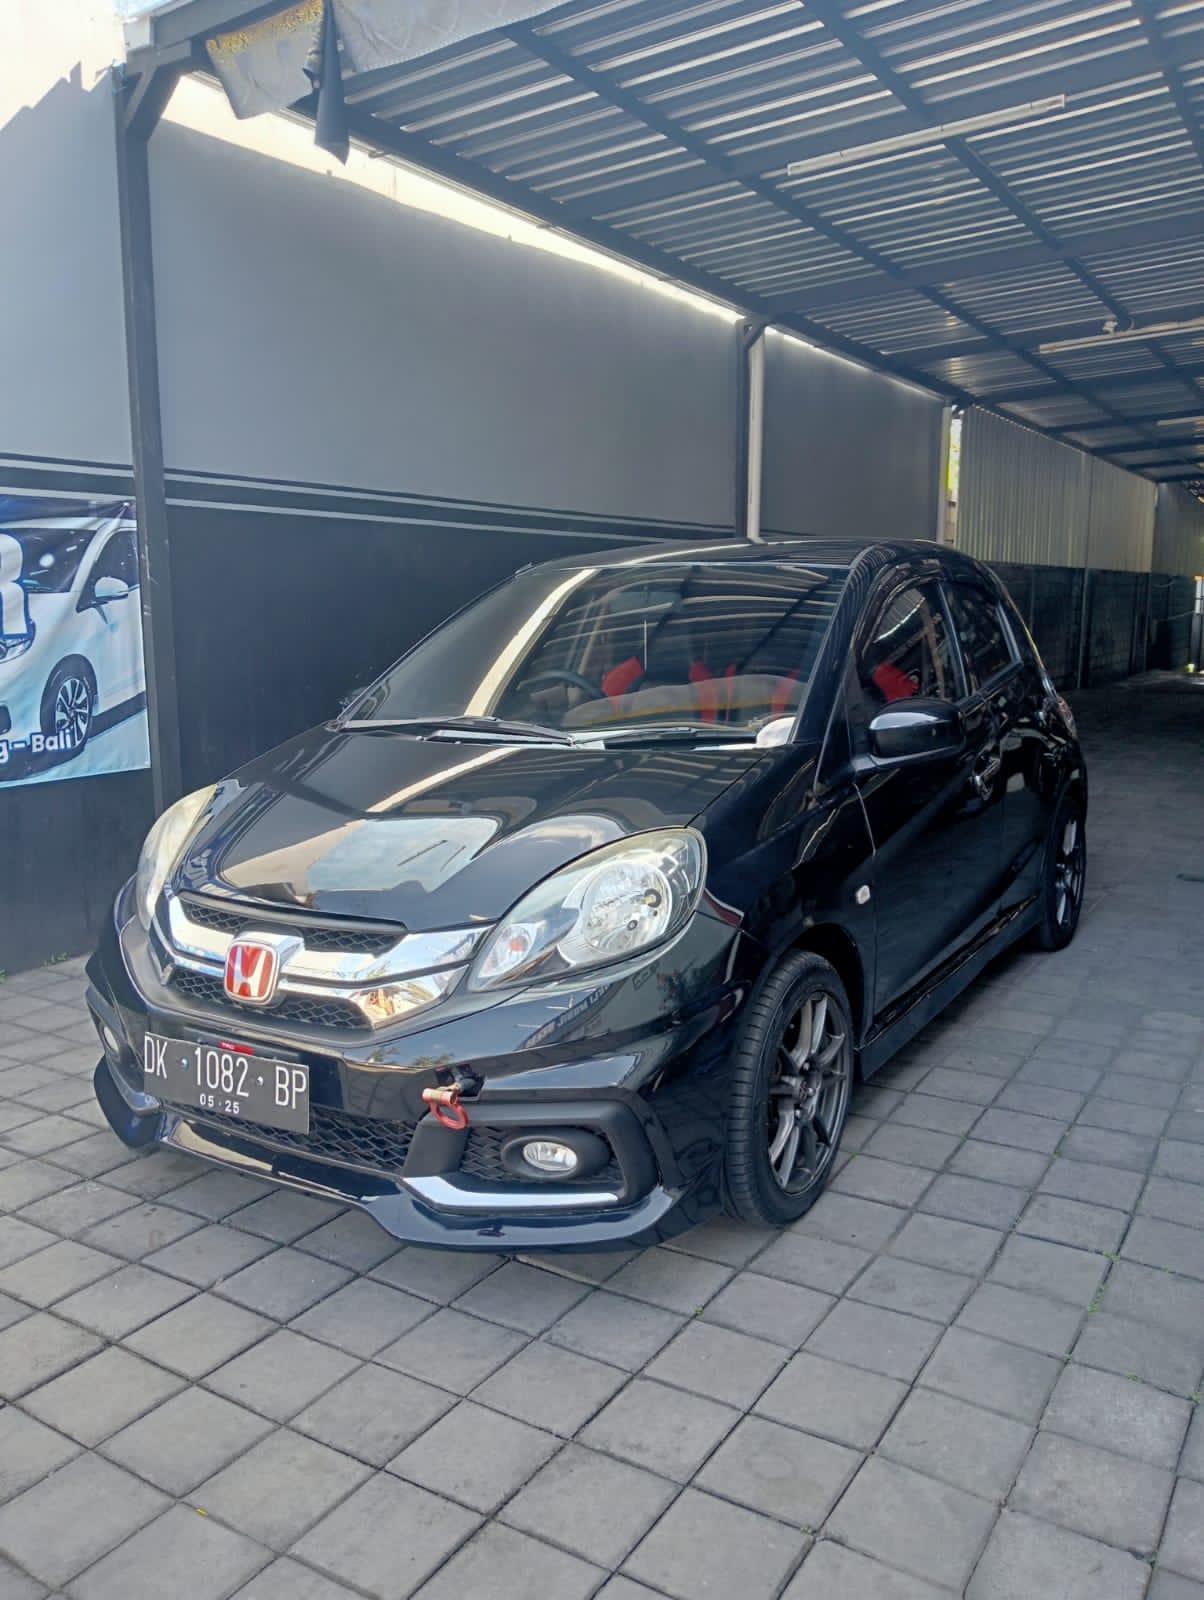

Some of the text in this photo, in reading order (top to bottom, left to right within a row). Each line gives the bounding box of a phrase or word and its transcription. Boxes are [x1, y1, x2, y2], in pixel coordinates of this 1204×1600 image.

[31, 729, 72, 753] Bali
[144, 1035, 307, 1110] DK 1082 BP
